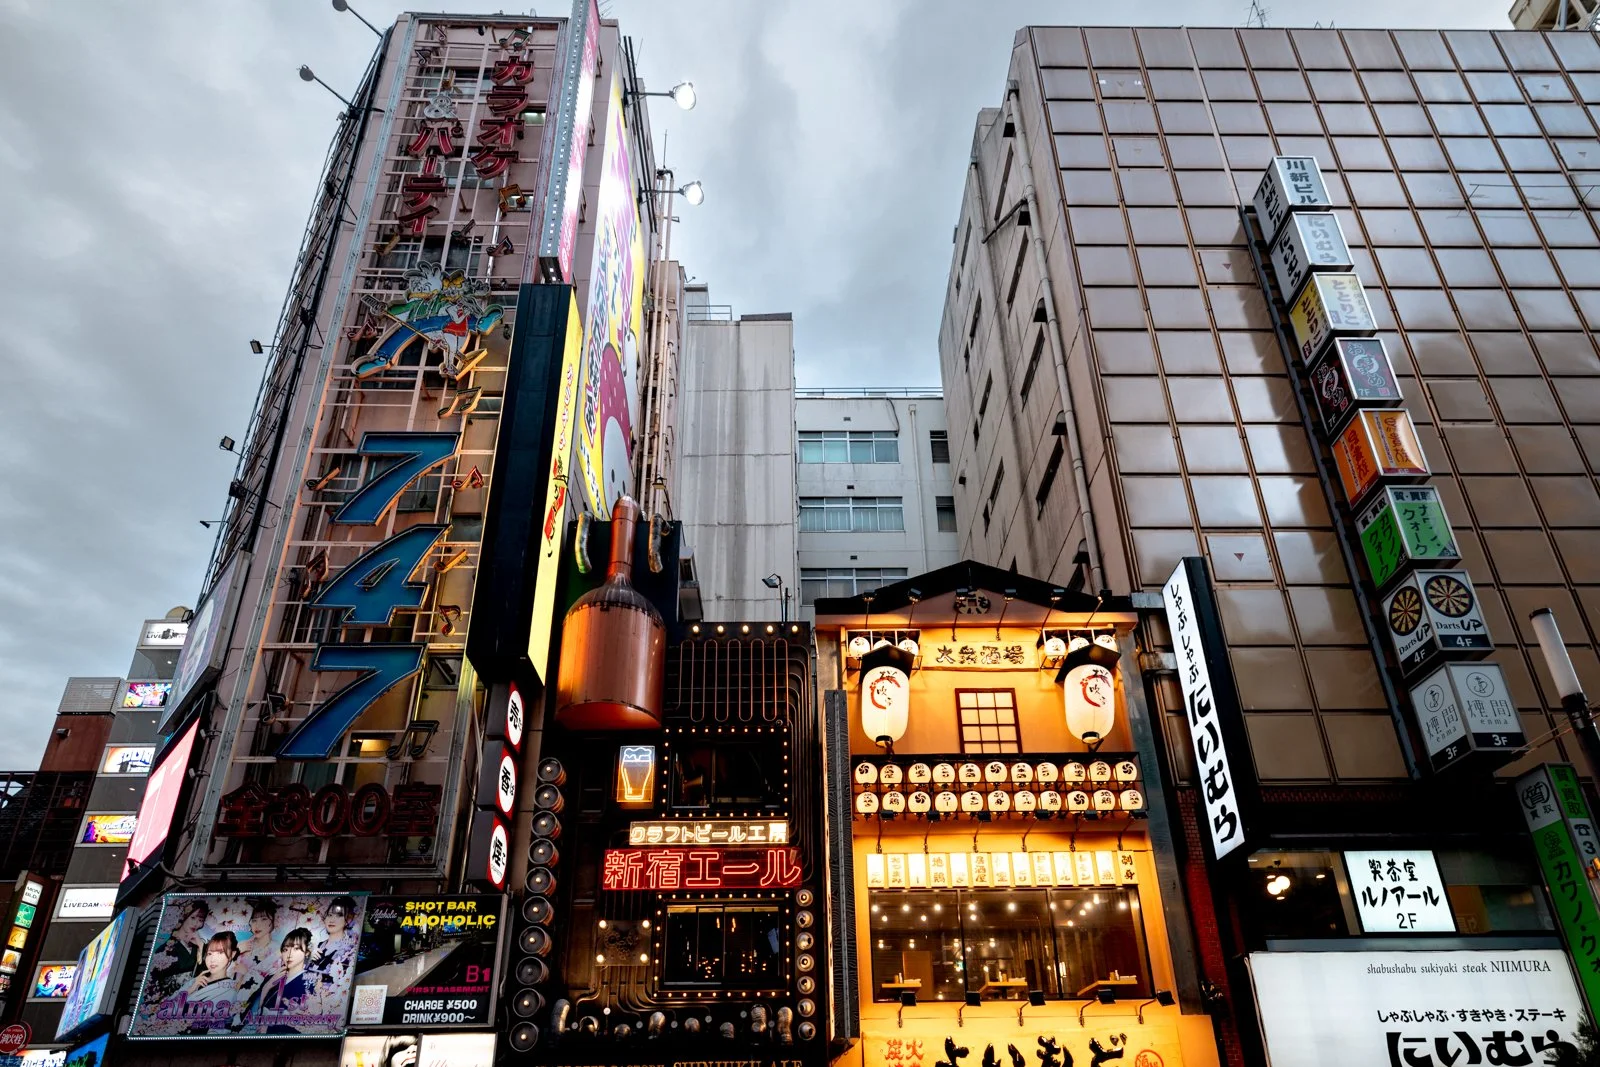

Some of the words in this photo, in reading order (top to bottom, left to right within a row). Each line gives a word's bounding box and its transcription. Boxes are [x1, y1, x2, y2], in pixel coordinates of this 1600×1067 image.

[477, 56, 534, 179] カラオケ
[1286, 160, 1318, 204] 川新ビル
[1308, 216, 1338, 262] にいむら
[1280, 232, 1302, 288] にいむら
[1456, 635, 1473, 647] 4F
[936, 644, 1025, 665] 大衆酒場
[1414, 648, 1426, 663] 4F
[1491, 734, 1508, 746] 3F
[1445, 745, 1458, 760] 3F
[1188, 683, 1238, 844] にいむら
[630, 823, 788, 843] クラフトビール工房
[604, 850, 802, 889] 新宿エール
[931, 857, 946, 883] 地鶏
[975, 855, 987, 883] 居酒屋
[1121, 855, 1135, 880] 刺身
[1368, 858, 1418, 882] 喫茶室
[405, 901, 445, 911] SHOT
[447, 901, 477, 911] BAR
[1362, 885, 1440, 908] ルノアール
[400, 914, 497, 928] ADOHOLIC
[1396, 912, 1417, 929] 2F
[466, 965, 491, 983] B1
[1367, 962, 1417, 976] shabushabu
[1420, 962, 1458, 977] sukiyaki
[1462, 962, 1488, 974] steak
[1490, 960, 1552, 974] NIIMURA
[269, 971, 310, 1012] 1st
[405, 986, 435, 994] FIRST
[436, 986, 490, 994] BASEMENT
[156, 990, 232, 1021] alma
[404, 1000, 444, 1011] CHARGE
[446, 1000, 478, 1010] ¥500
[1377, 1008, 1567, 1023] しゃぶしゃぶ・すきやき・ステーキ
[243, 1010, 342, 1031] Anniversary
